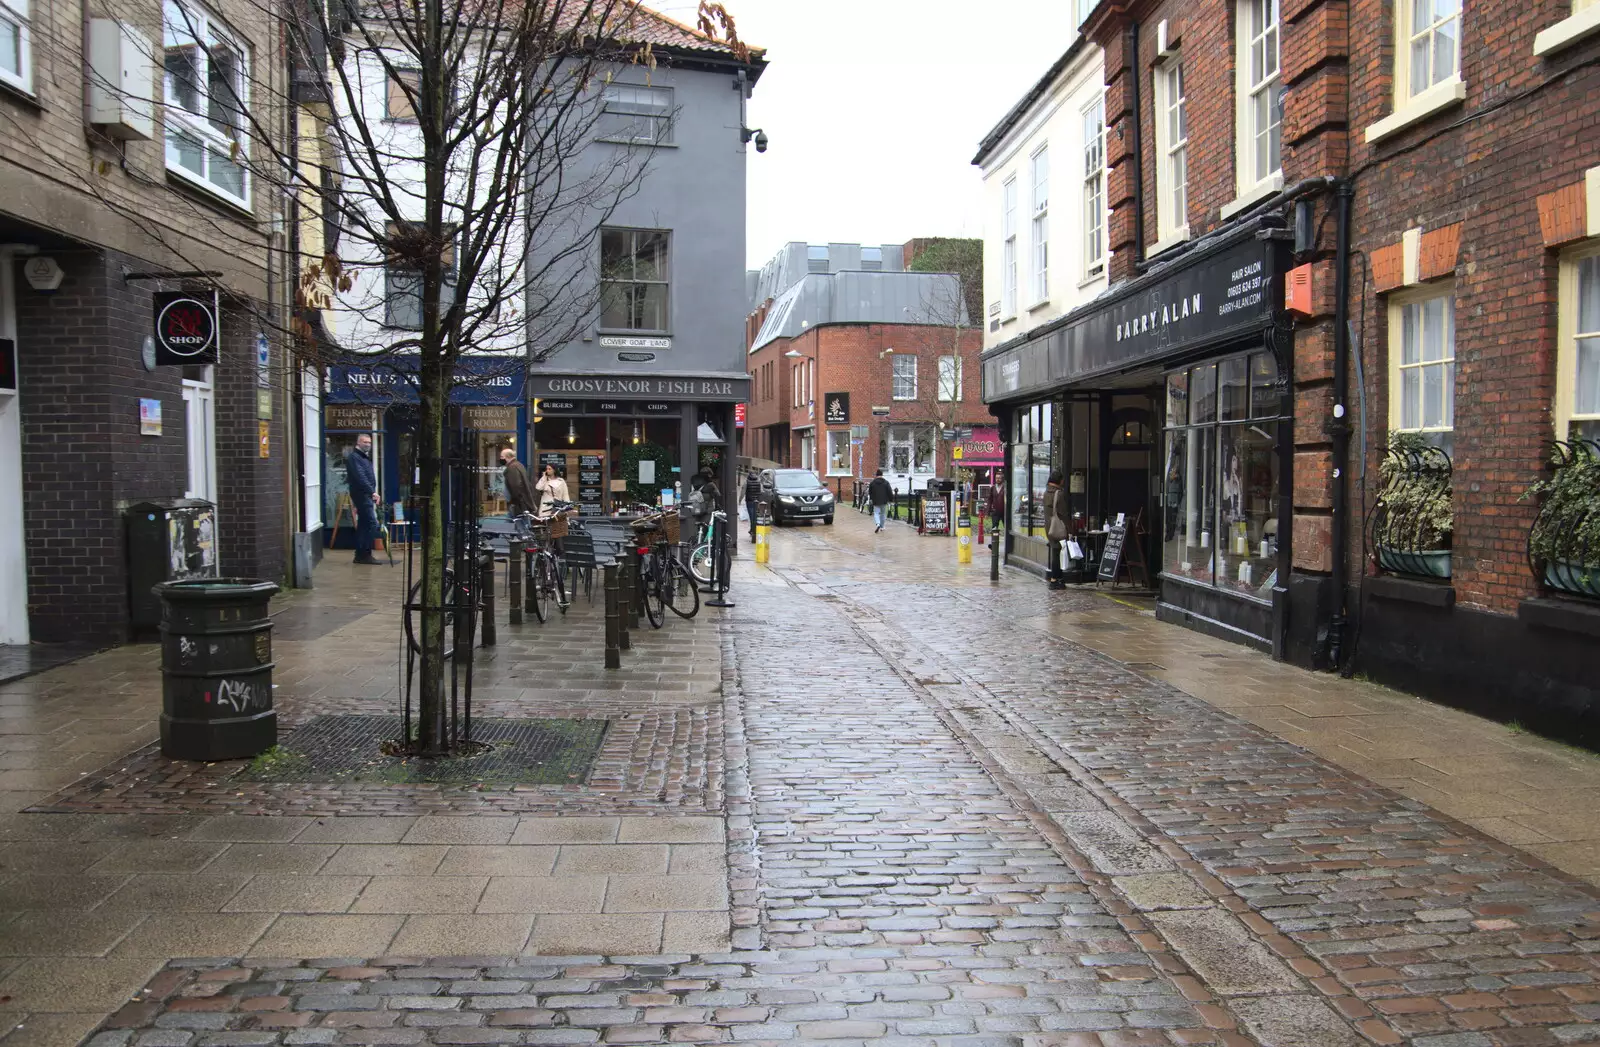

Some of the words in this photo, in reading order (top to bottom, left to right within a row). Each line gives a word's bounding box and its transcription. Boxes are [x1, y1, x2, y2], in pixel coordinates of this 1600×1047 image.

[1231, 268, 1244, 282] HAIR
[1244, 261, 1262, 277] SALON
[1227, 283, 1242, 298] 01603
[1241, 281, 1251, 293] 624
[1251, 276, 1262, 289] 397
[1219, 292, 1262, 316] BARRY-ALAN.COM
[1116, 310, 1157, 342] BARRY
[1162, 293, 1202, 326] ALAN
[168, 336, 204, 344] SHOP
[603, 338, 627, 346] LOWER
[548, 378, 651, 394] GROSVENOR
[657, 381, 695, 394] FISH
[701, 381, 733, 395] BAR
[468, 409, 512, 418] THERAPY
[336, 419, 373, 428] ROOMS
[473, 419, 508, 428] ROOMS
